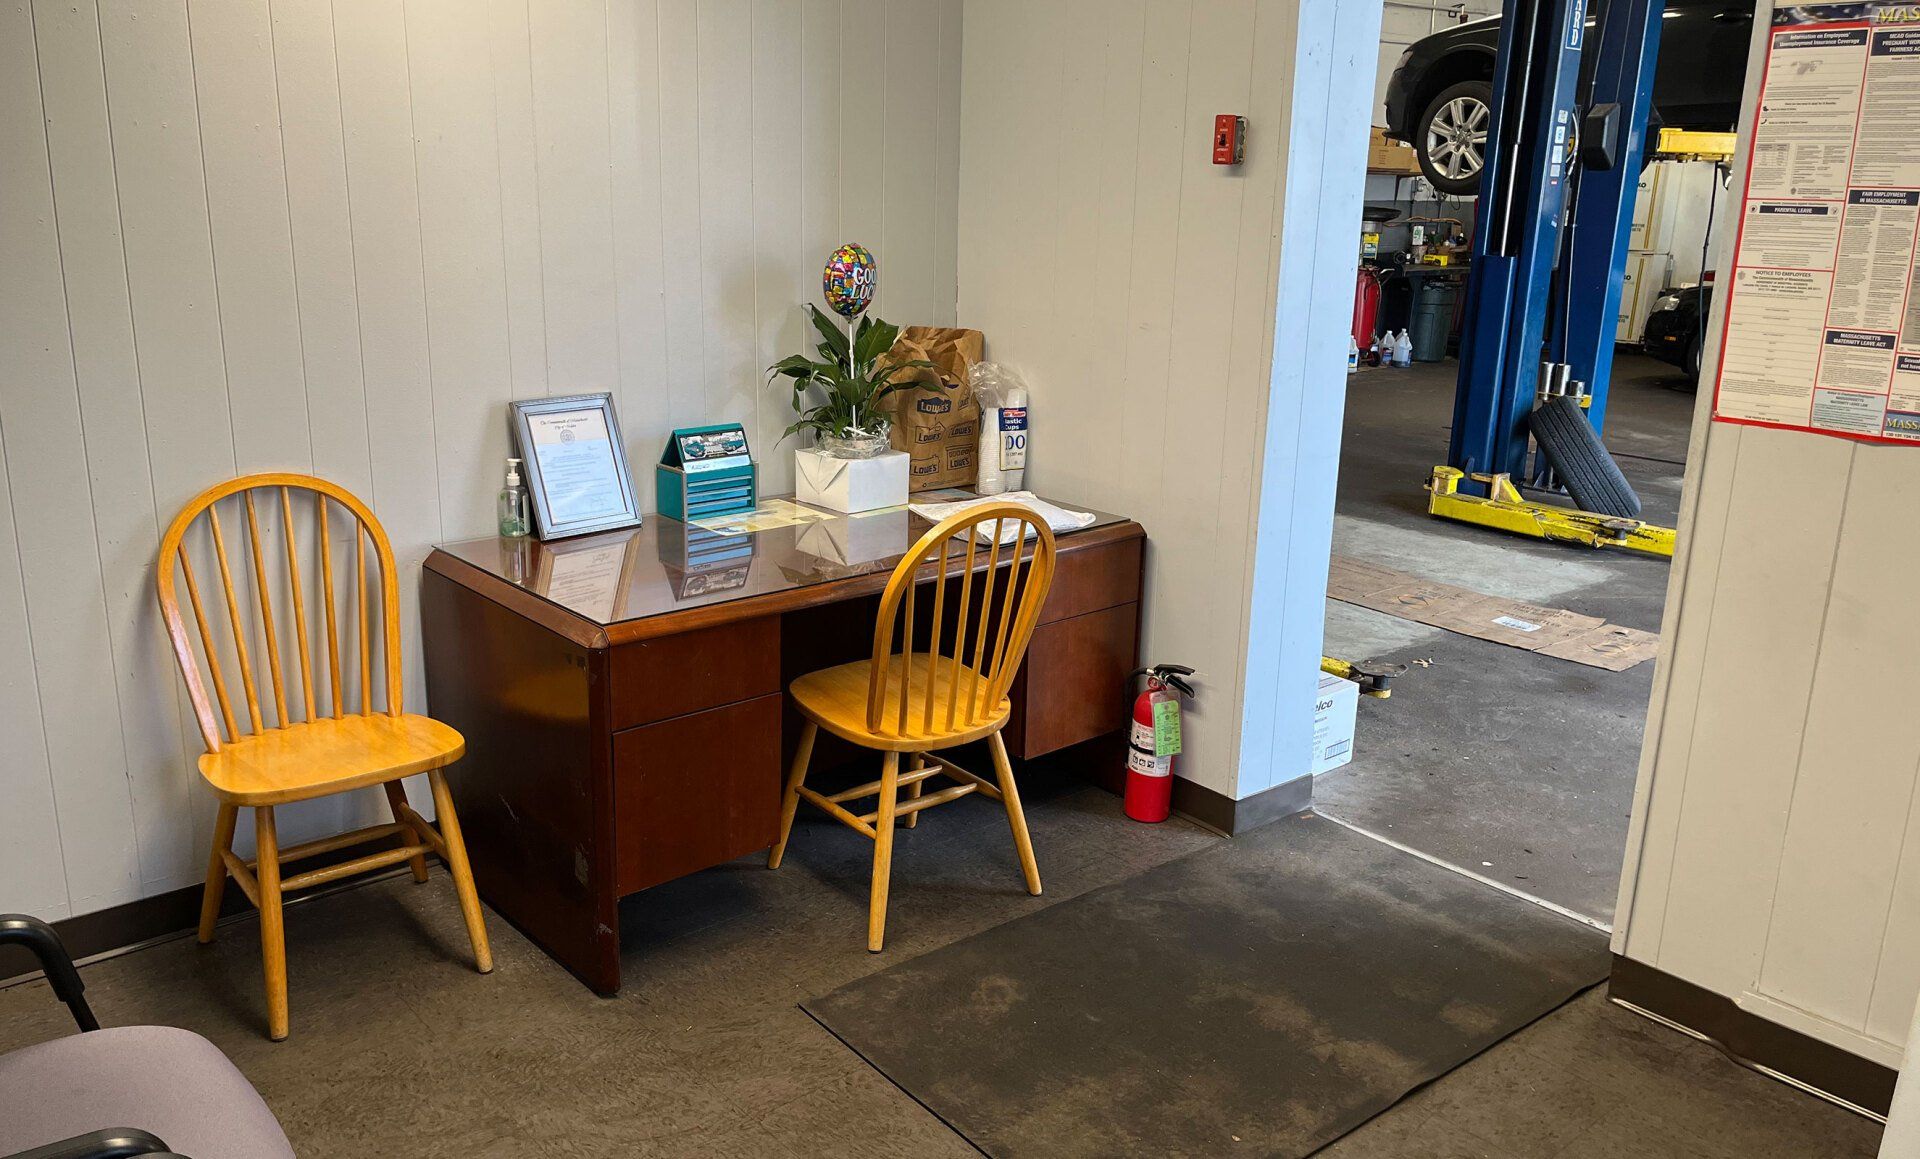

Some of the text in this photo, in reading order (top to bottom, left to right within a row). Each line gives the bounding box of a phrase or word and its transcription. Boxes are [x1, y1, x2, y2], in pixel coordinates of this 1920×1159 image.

[853, 267, 877, 285] GOO
[851, 284, 876, 300] LUC
[1840, 333, 1881, 341] MASSACHUSETTS
[1886, 418, 1920, 430] MASS
